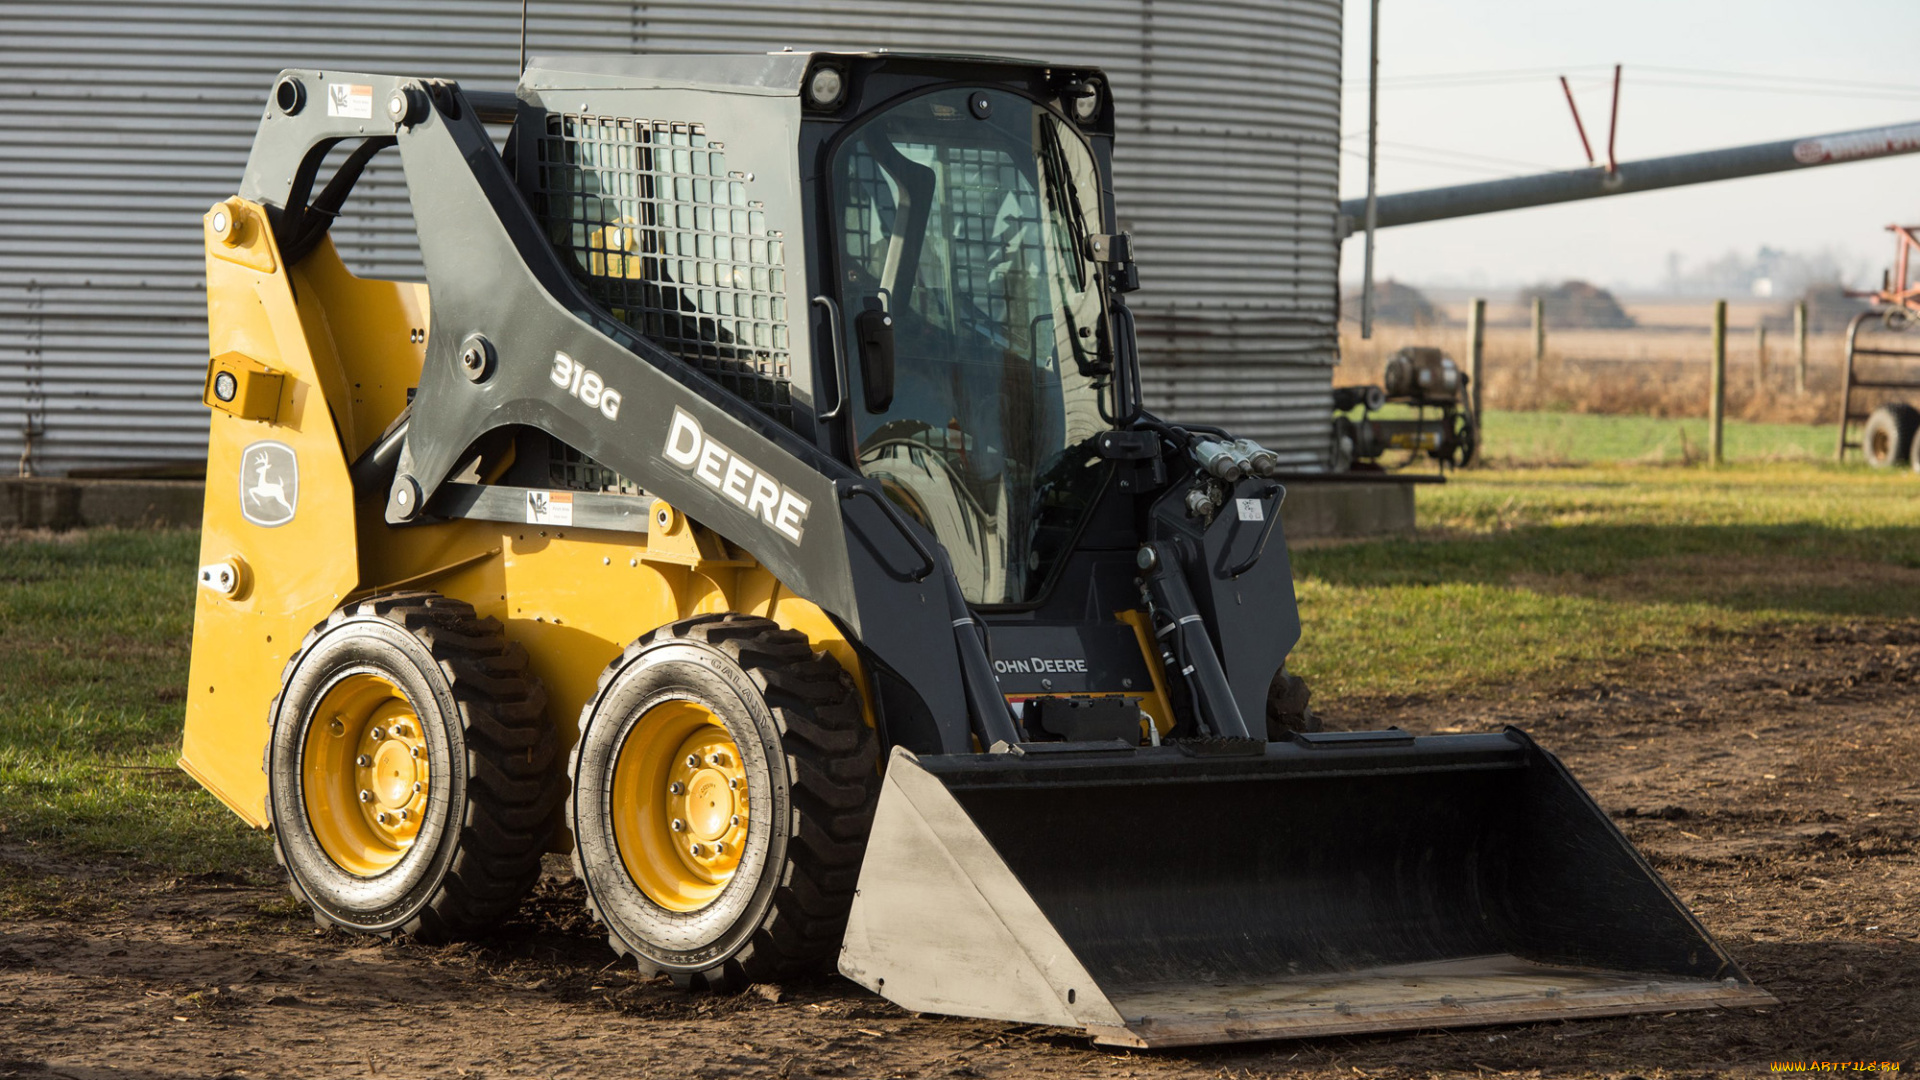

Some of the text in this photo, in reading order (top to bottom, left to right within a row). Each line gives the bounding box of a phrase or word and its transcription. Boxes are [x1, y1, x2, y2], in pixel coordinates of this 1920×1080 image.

[550, 351, 622, 421] 318G
[663, 406, 810, 545] DEERE
[711, 658, 769, 730] GALAXY
[994, 657, 1088, 678] OHN DEERE
